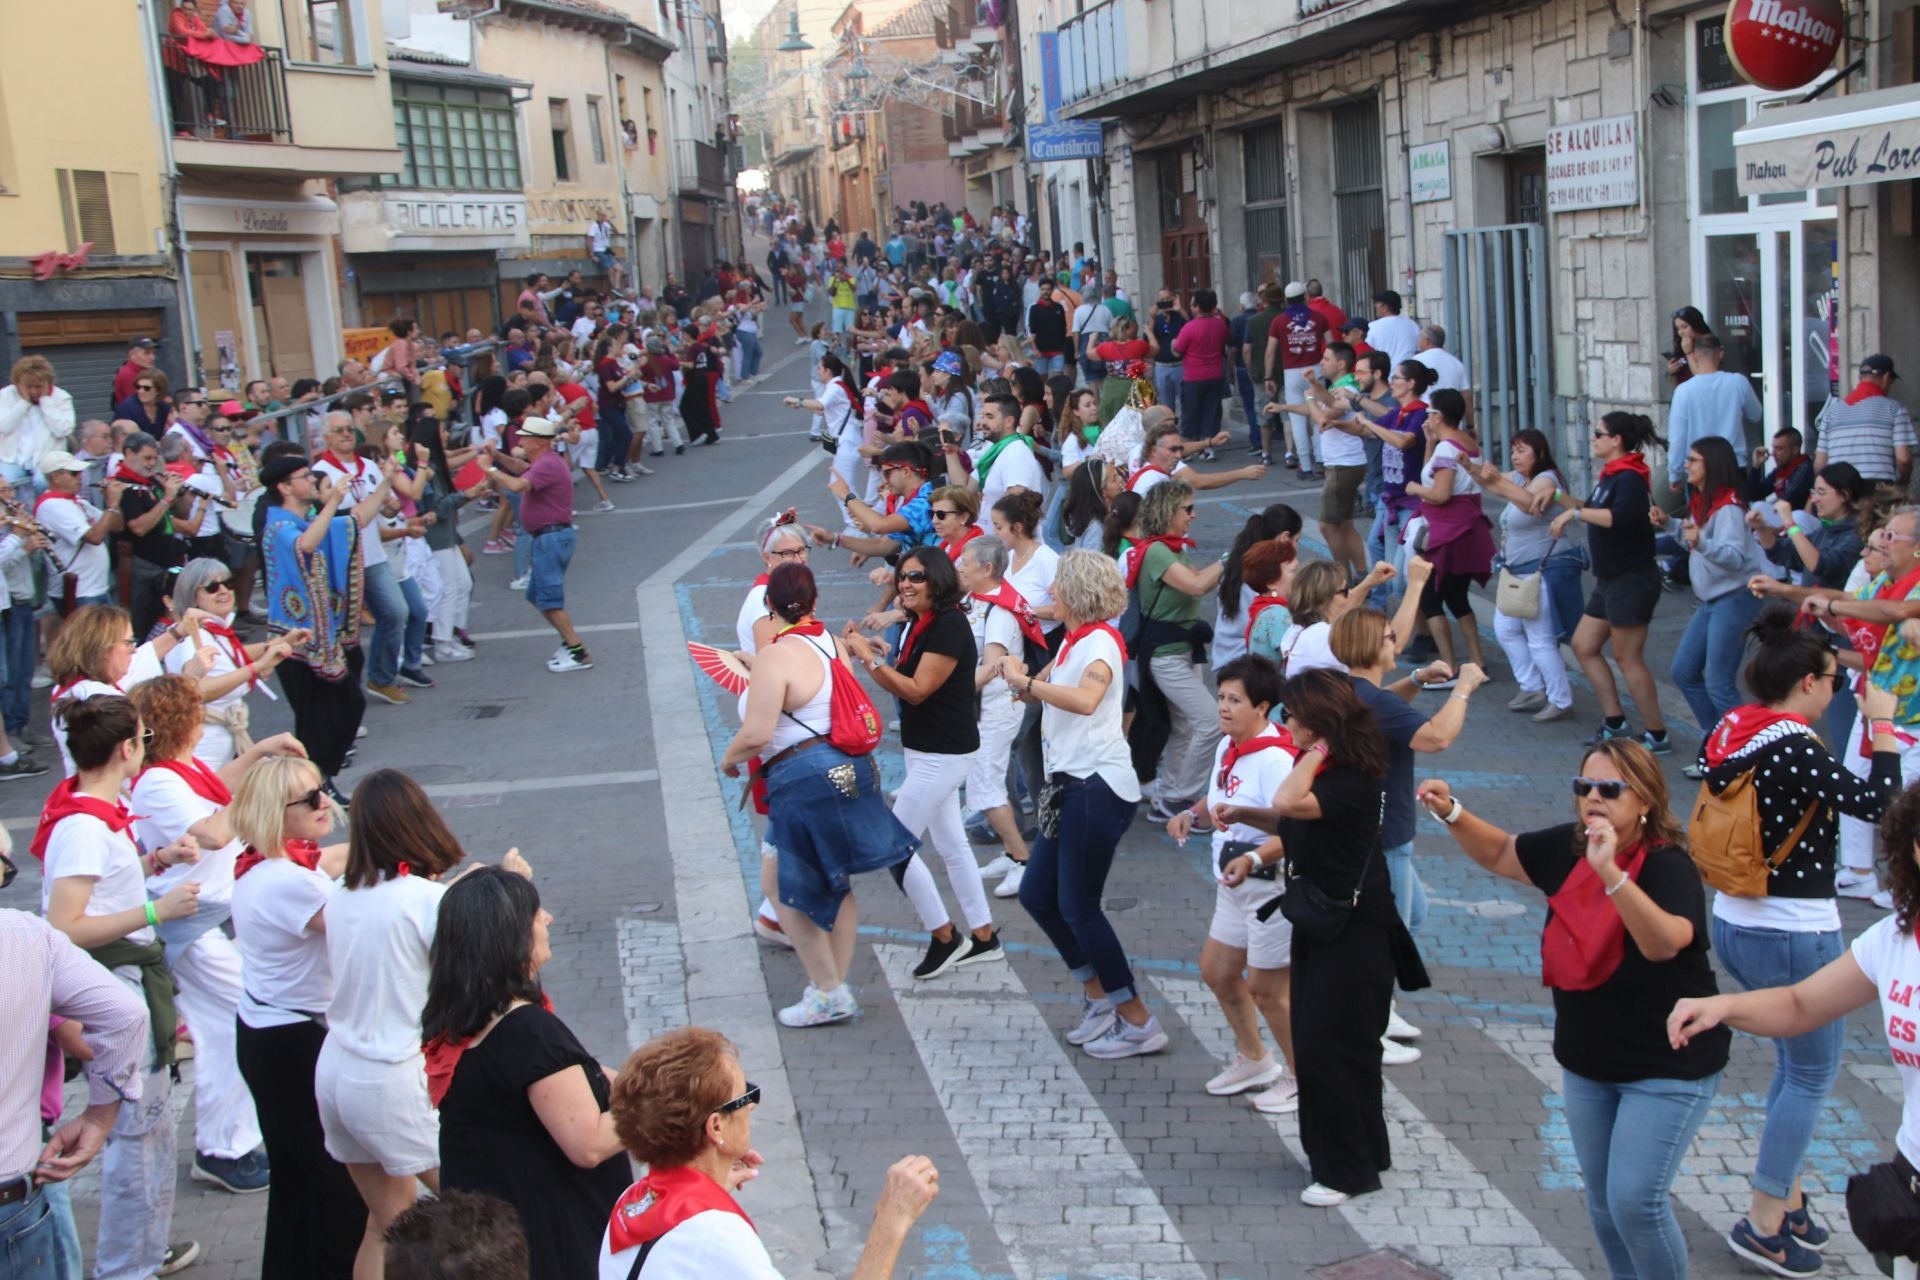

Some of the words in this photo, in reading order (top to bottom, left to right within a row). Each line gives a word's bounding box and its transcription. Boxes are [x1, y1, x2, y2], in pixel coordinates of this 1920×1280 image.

[1703, 26, 1726, 47] PE
[1748, 0, 1836, 45] Mahou
[1032, 140, 1100, 158] Cantábrico
[1548, 132, 1562, 155] SE
[1568, 120, 1632, 152] ALQUILAN
[1547, 163, 1575, 179] LOCALES
[1576, 162, 1587, 176] DE
[1746, 161, 1786, 181] Mahou
[1815, 137, 1860, 182] Pub
[395, 203, 517, 229] BICICLETAS
[1888, 979, 1913, 1008] LA
[1889, 1015, 1917, 1044] ES
